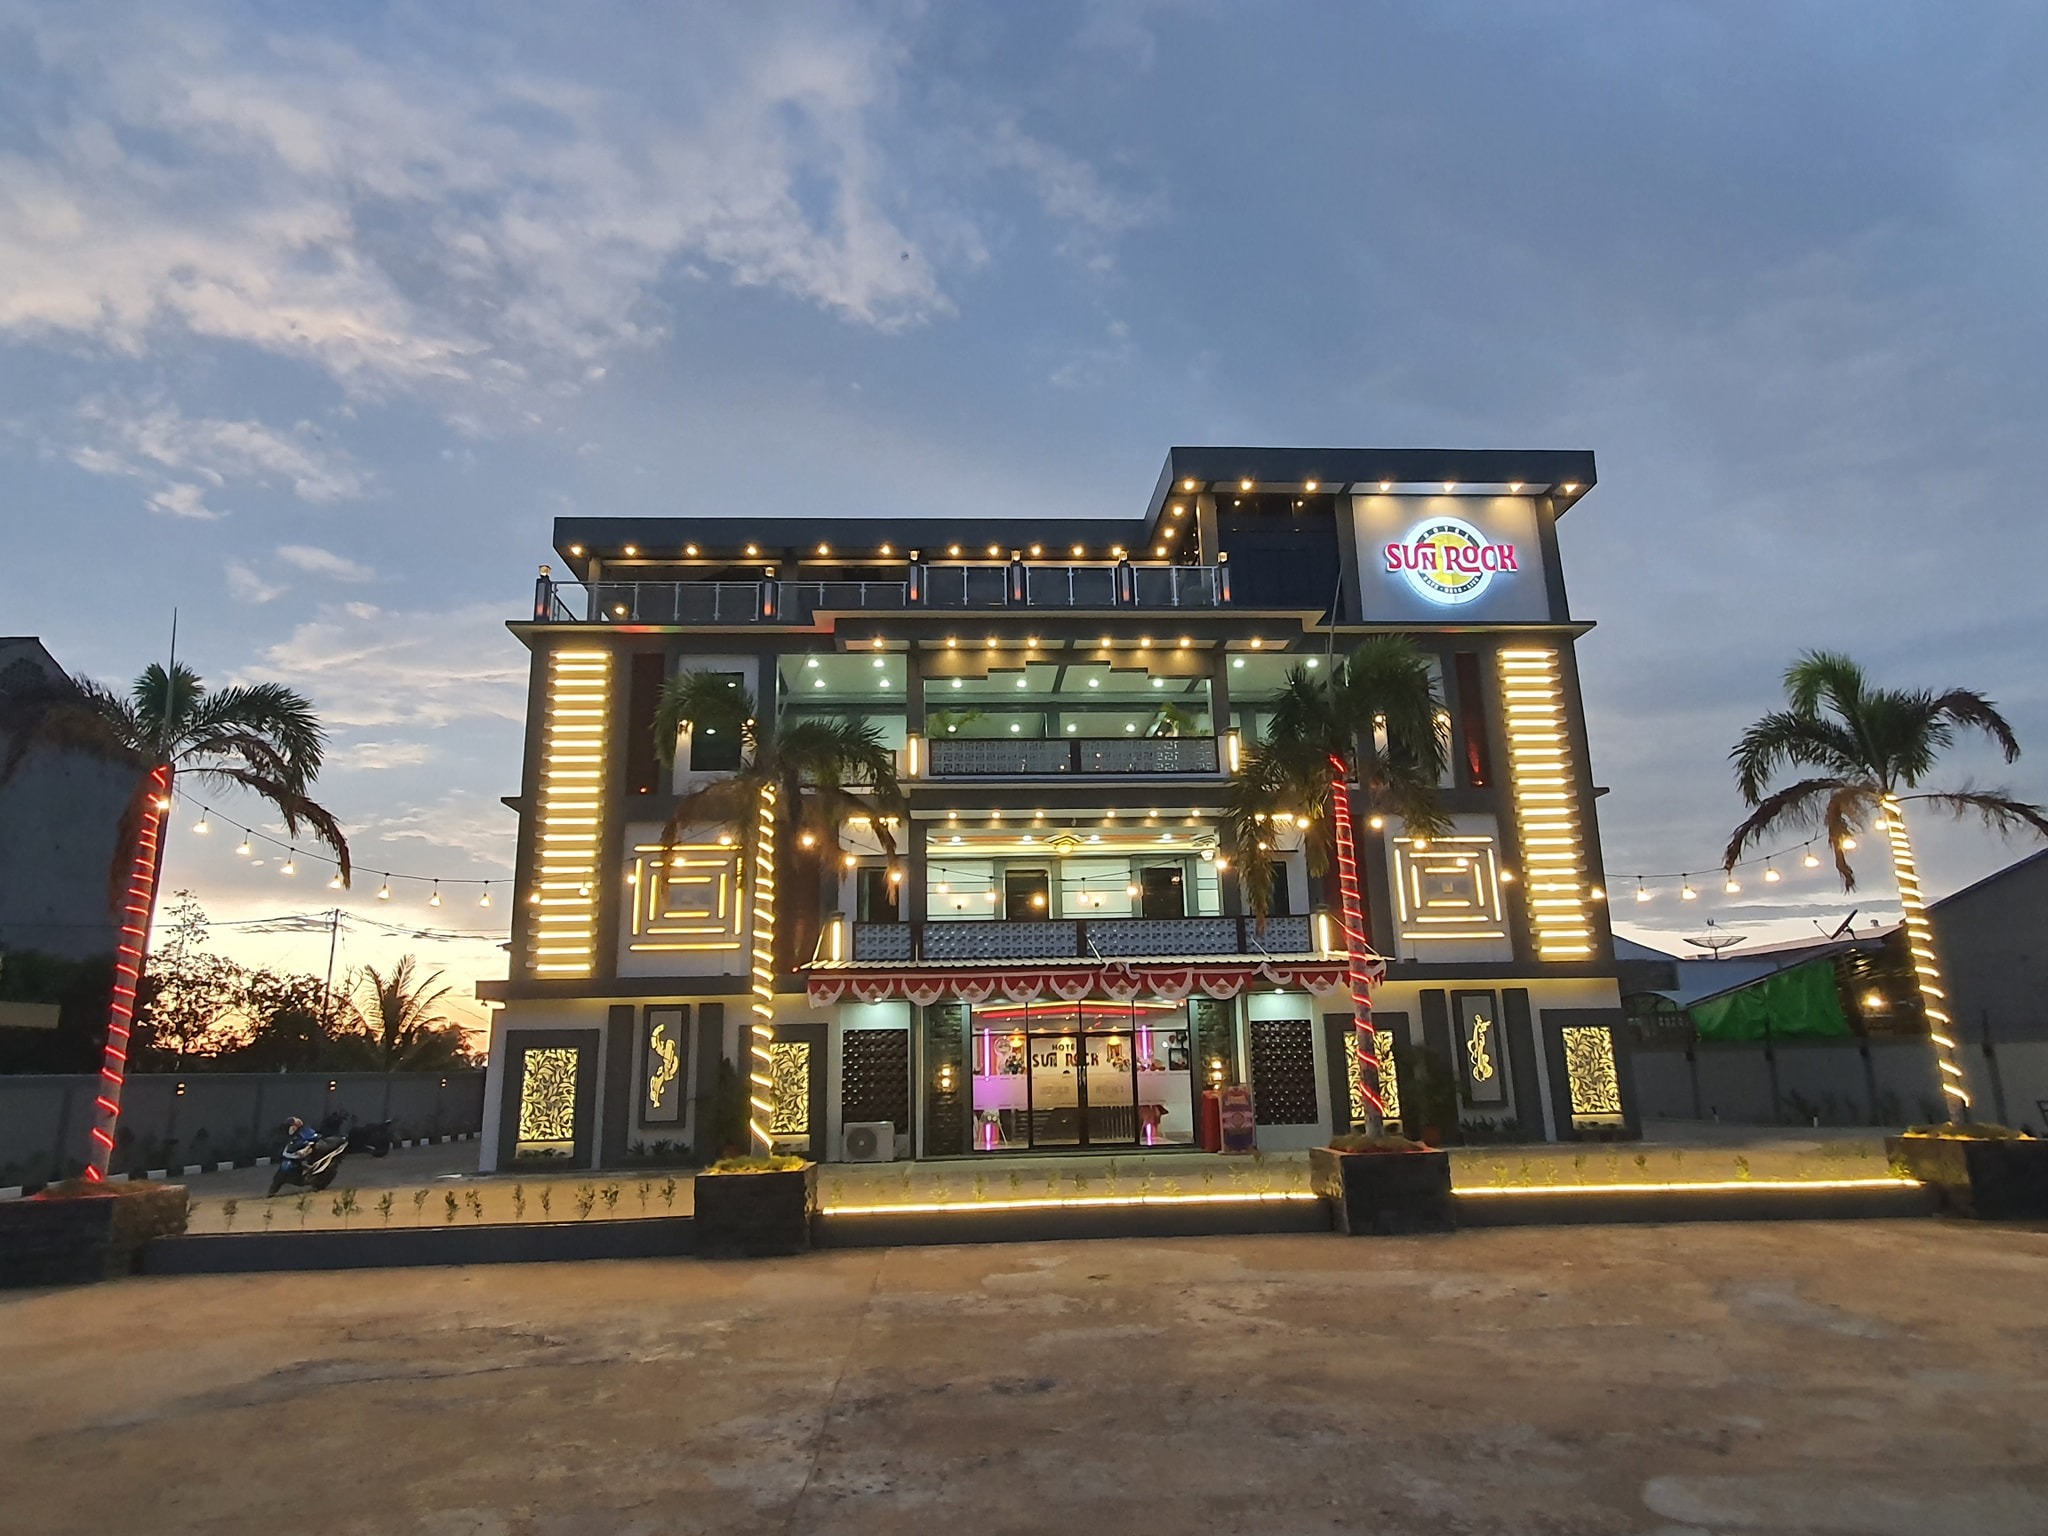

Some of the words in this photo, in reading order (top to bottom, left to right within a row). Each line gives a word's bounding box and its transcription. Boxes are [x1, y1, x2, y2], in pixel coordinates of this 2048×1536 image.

[1386, 543, 1438, 570] SUN
[1444, 544, 1518, 573] ROCK
[1032, 1053, 1057, 1067] SUN
